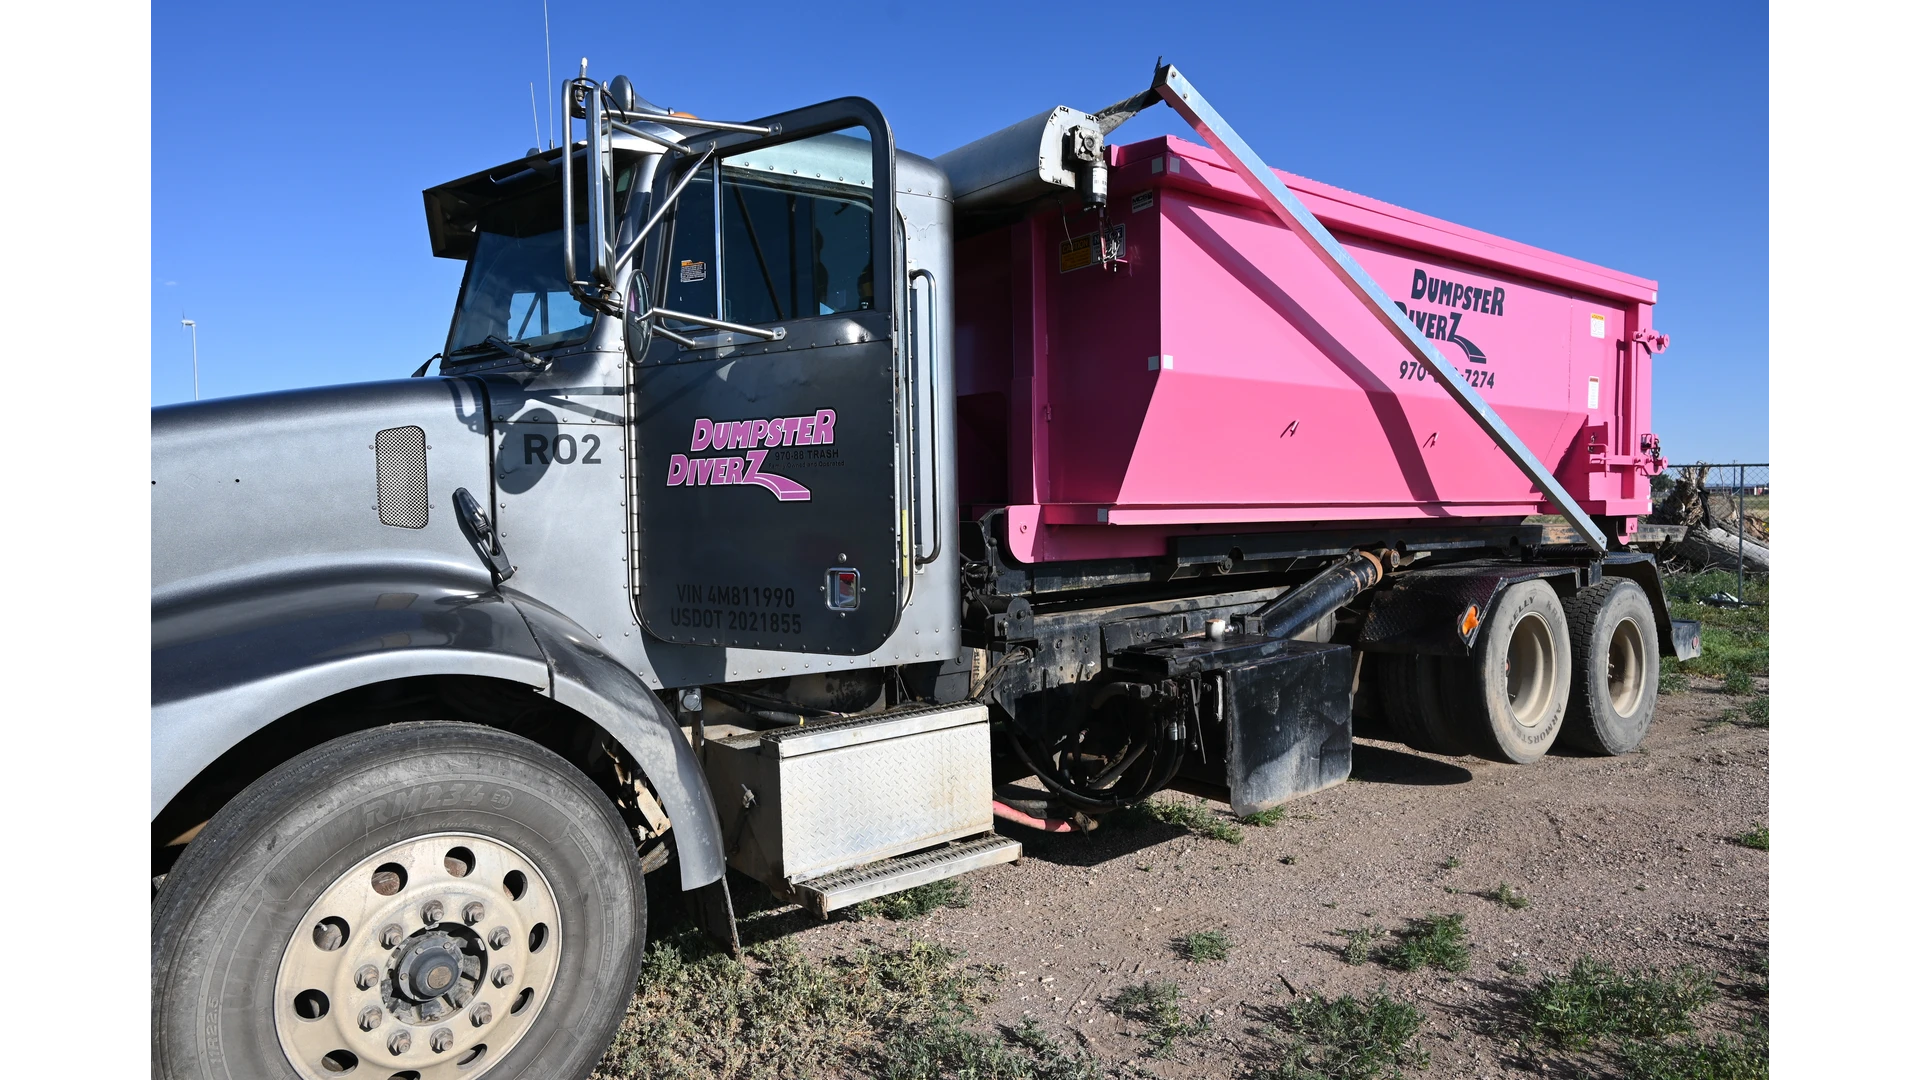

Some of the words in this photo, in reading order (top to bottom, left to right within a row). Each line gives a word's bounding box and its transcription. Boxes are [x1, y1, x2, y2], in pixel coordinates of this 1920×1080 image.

[1411, 268, 1505, 316] DUMPSTER
[690, 409, 837, 451] DUMPSTER
[807, 449, 839, 459] TRASH
[676, 584, 702, 604] VIN
[707, 585, 795, 609] 4M811990
[1508, 595, 1535, 632] KELLY
[670, 607, 723, 630] USDOT
[728, 610, 802, 635] 2021855
[363, 783, 485, 828] RM234
